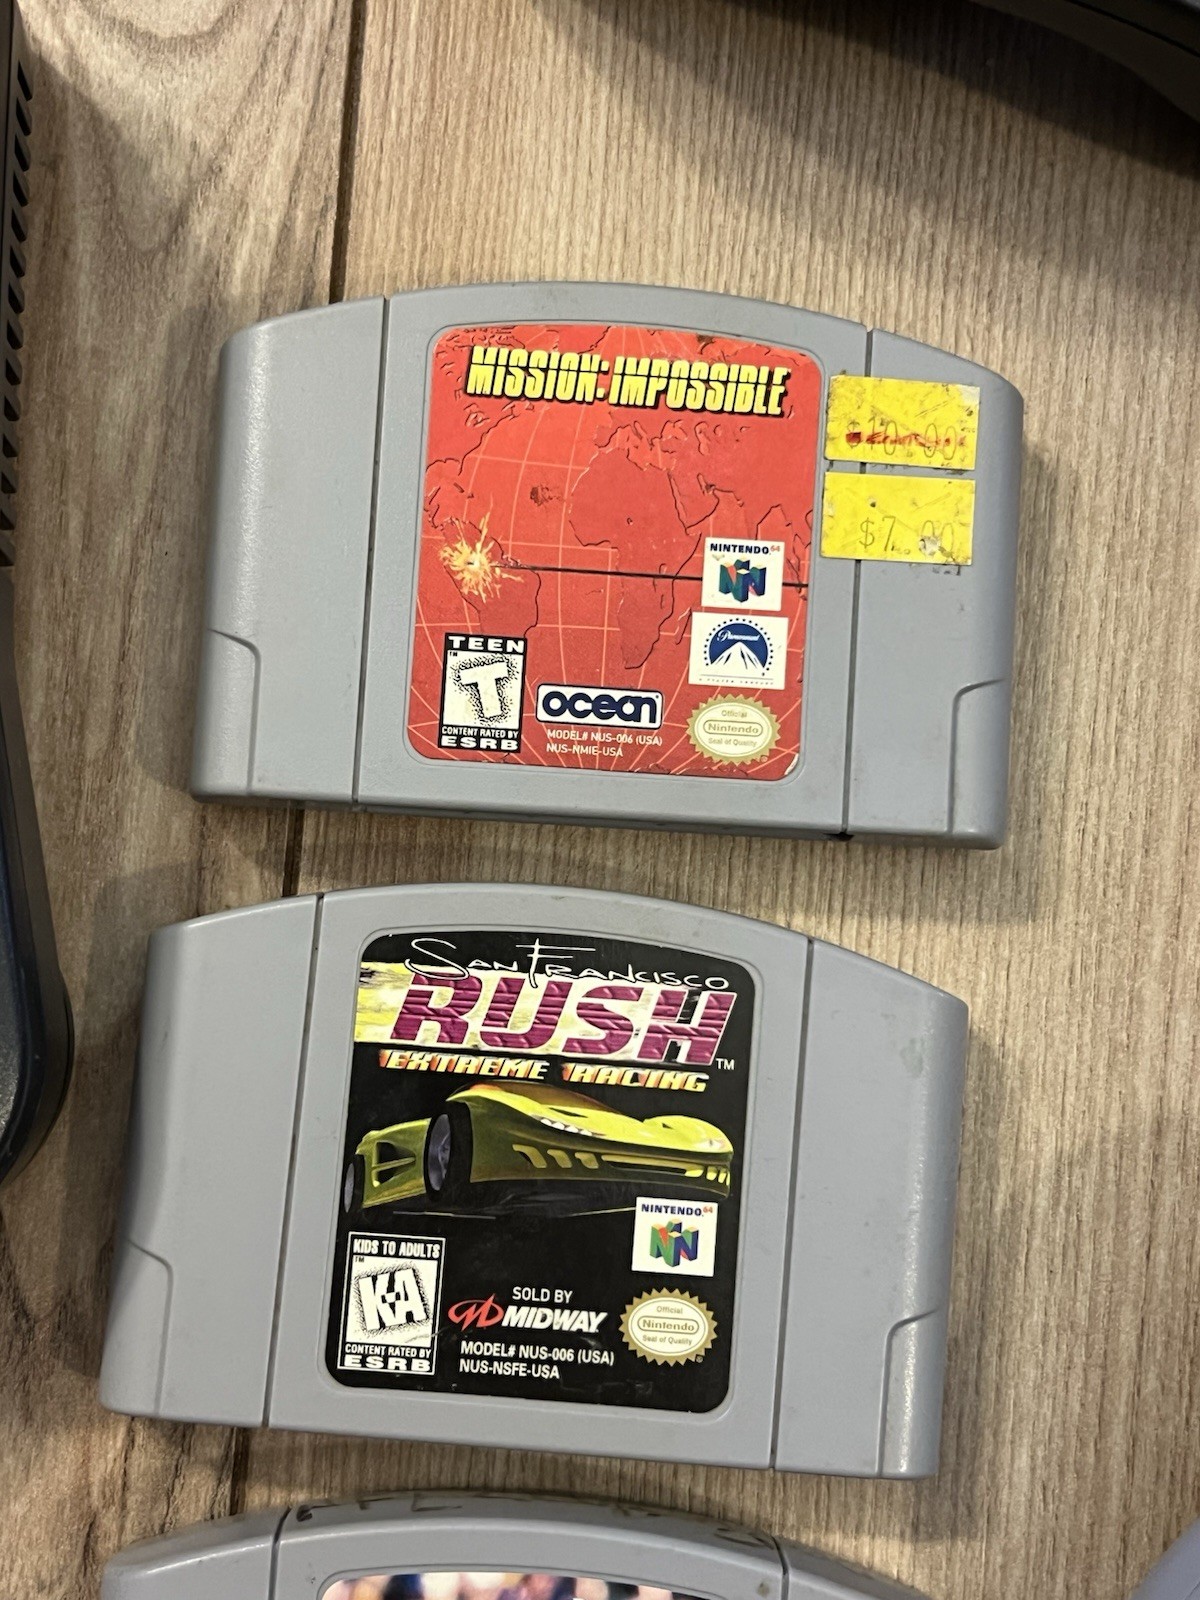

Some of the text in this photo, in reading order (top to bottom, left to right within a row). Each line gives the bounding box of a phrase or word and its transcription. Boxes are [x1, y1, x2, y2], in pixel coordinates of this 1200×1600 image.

[467, 345, 792, 417] MISSION: IMPOSSIBLE
[710, 542, 769, 555] NINTENDO
[448, 636, 525, 654] TEEN
[460, 661, 510, 718] T
[542, 690, 657, 724] ocean
[721, 709, 748, 718] Official
[441, 726, 519, 739] CONTENT RATED BY
[707, 723, 759, 734] Nintendo
[441, 735, 518, 751] ESRB
[547, 729, 662, 746] MODEL# NUS-006 (USA)
[732, 739, 757, 748] Quality
[546, 744, 623, 757] NUS-NMIE-USA
[389, 972, 737, 1066] RUSH
[379, 1049, 710, 1093] EXTREME RACING
[716, 1058, 735, 1070] TM
[641, 1203, 702, 1217] NINTENDO
[353, 1239, 441, 1259] KIDS TO ADULTS
[512, 1286, 573, 1303] SOLD BY
[656, 1305, 684, 1315] Official
[501, 1305, 608, 1334] MIDWAY
[642, 1319, 695, 1332] Nintendo
[642, 1335, 658, 1343] Seal
[668, 1337, 693, 1346] Quality
[345, 1344, 432, 1359] CONTENT RATED BY
[460, 1341, 615, 1366] MODEL# NUS-006 (USA)
[344, 1354, 431, 1372] ESRB
[459, 1359, 560, 1379] NUS-NSFE-USA
